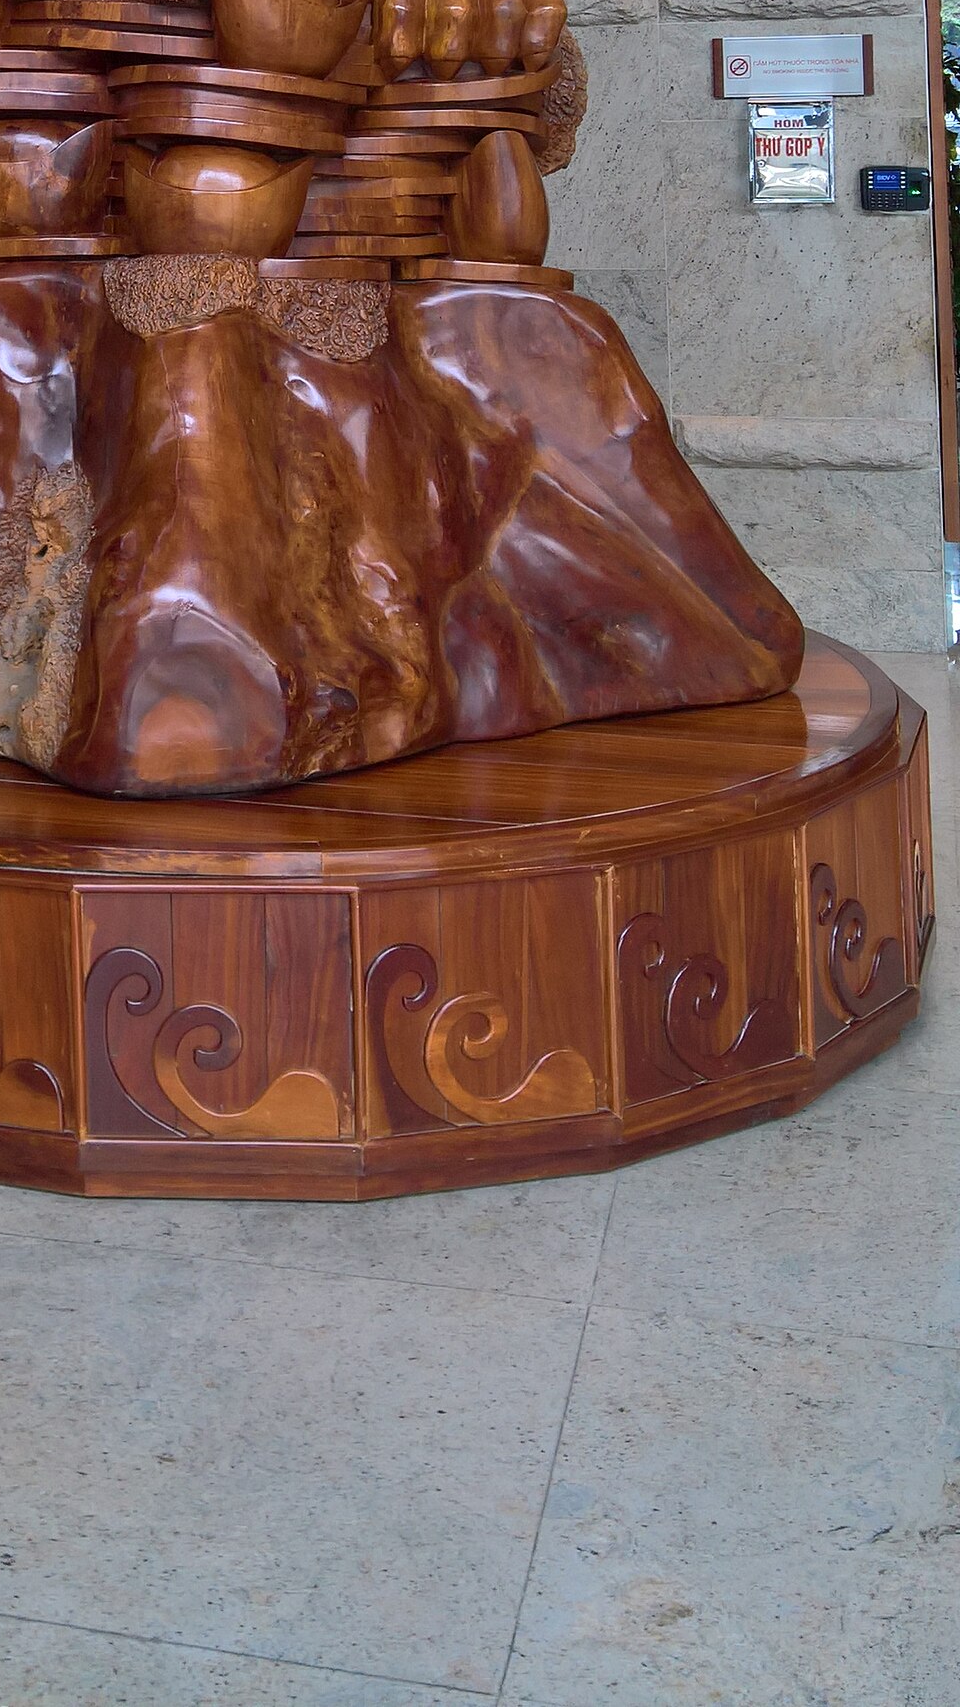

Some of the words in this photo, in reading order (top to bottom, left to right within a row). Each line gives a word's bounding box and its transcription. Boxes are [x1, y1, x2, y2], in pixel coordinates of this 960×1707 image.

[755, 135, 782, 157] THƯ
[786, 133, 812, 157] GÓP
[817, 133, 825, 157] Ý
